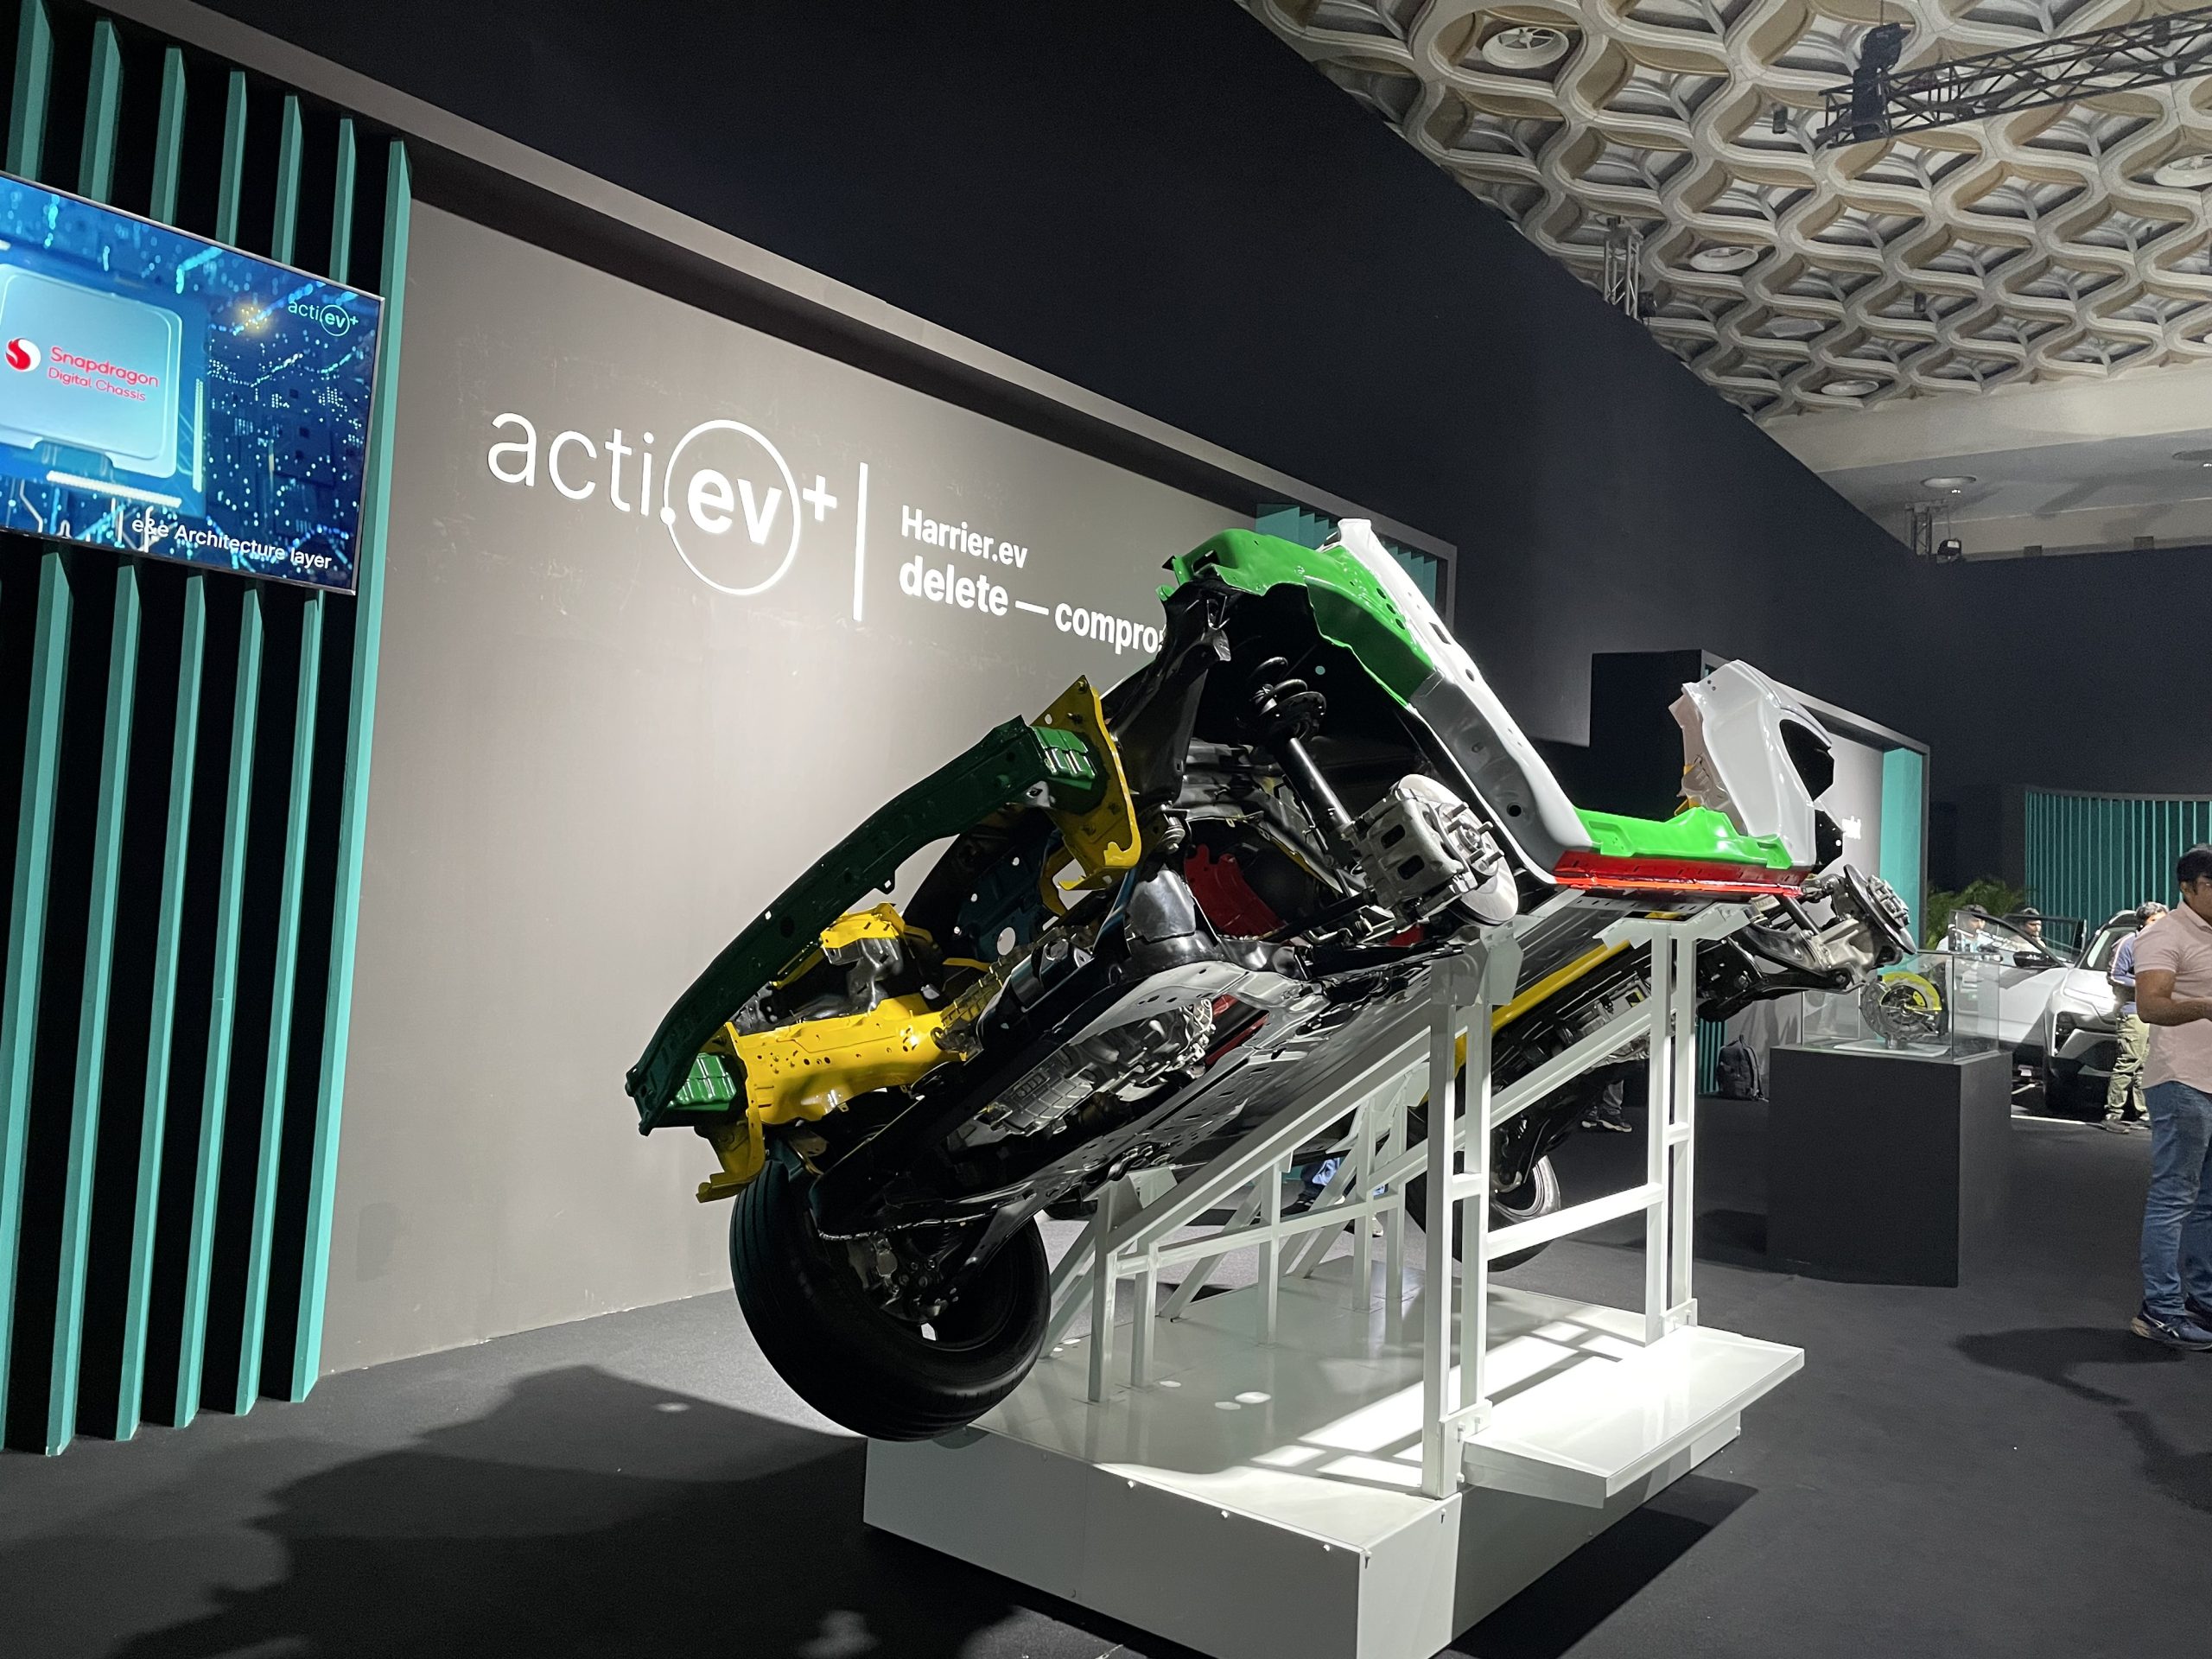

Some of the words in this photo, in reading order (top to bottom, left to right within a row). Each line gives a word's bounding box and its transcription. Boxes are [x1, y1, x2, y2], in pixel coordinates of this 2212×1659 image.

[48, 366, 92, 386] Digital
[96, 379, 146, 402] Chassis
[50, 346, 159, 388] Snapdragon
[174, 524, 286, 561] Architecture
[290, 547, 333, 569] layer
[901, 505, 1028, 569] Harrier.ev
[899, 555, 1009, 617] delete
